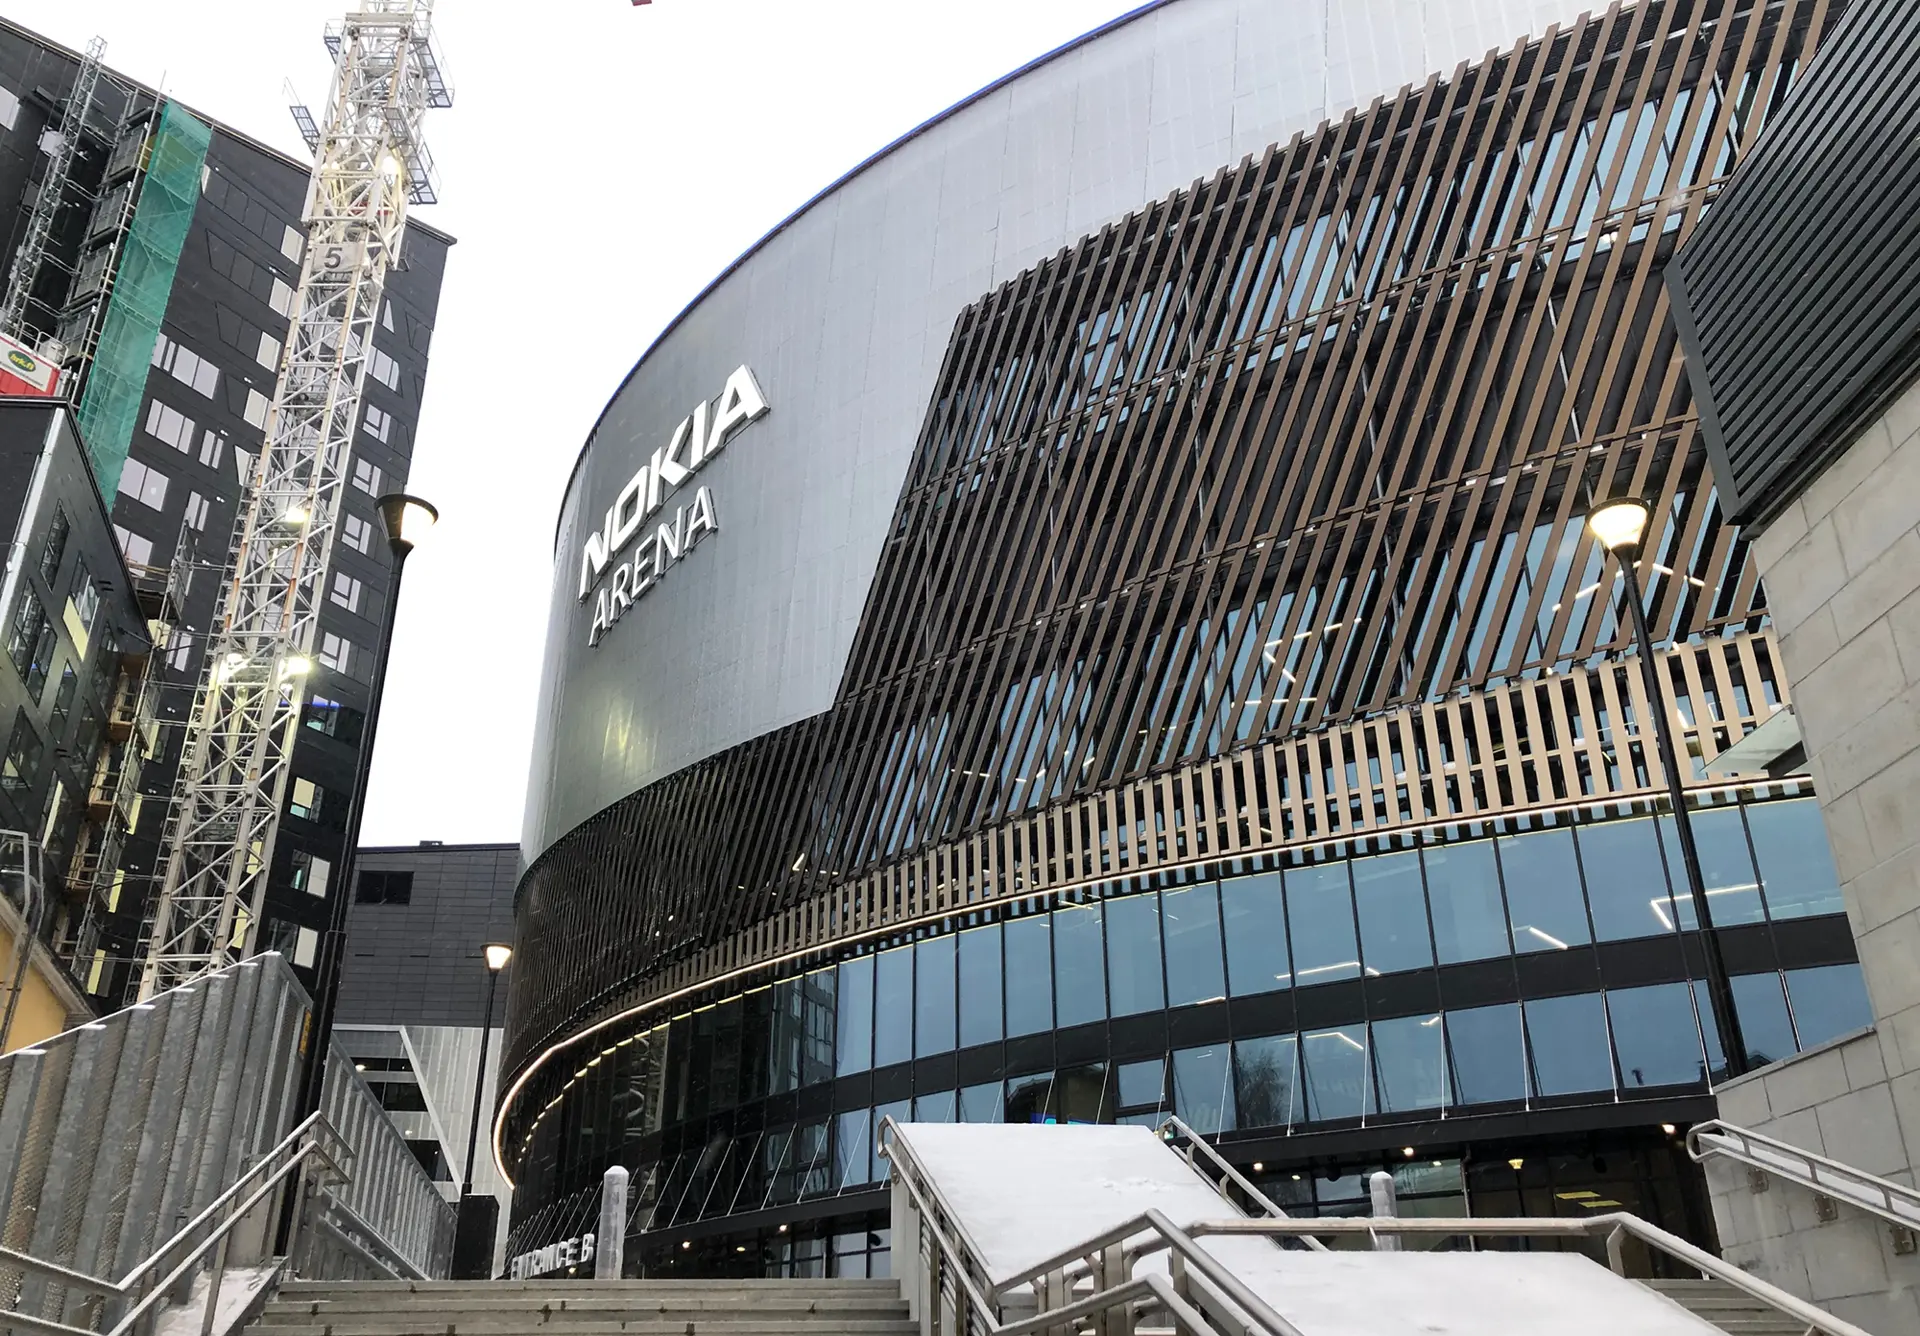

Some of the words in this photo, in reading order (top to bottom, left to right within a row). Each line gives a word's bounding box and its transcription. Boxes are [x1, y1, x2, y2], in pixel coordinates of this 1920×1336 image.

[324, 247, 342, 268] 5
[578, 364, 770, 601] NOKIA
[588, 485, 718, 648] ARENA
[581, 1233, 595, 1263] B
